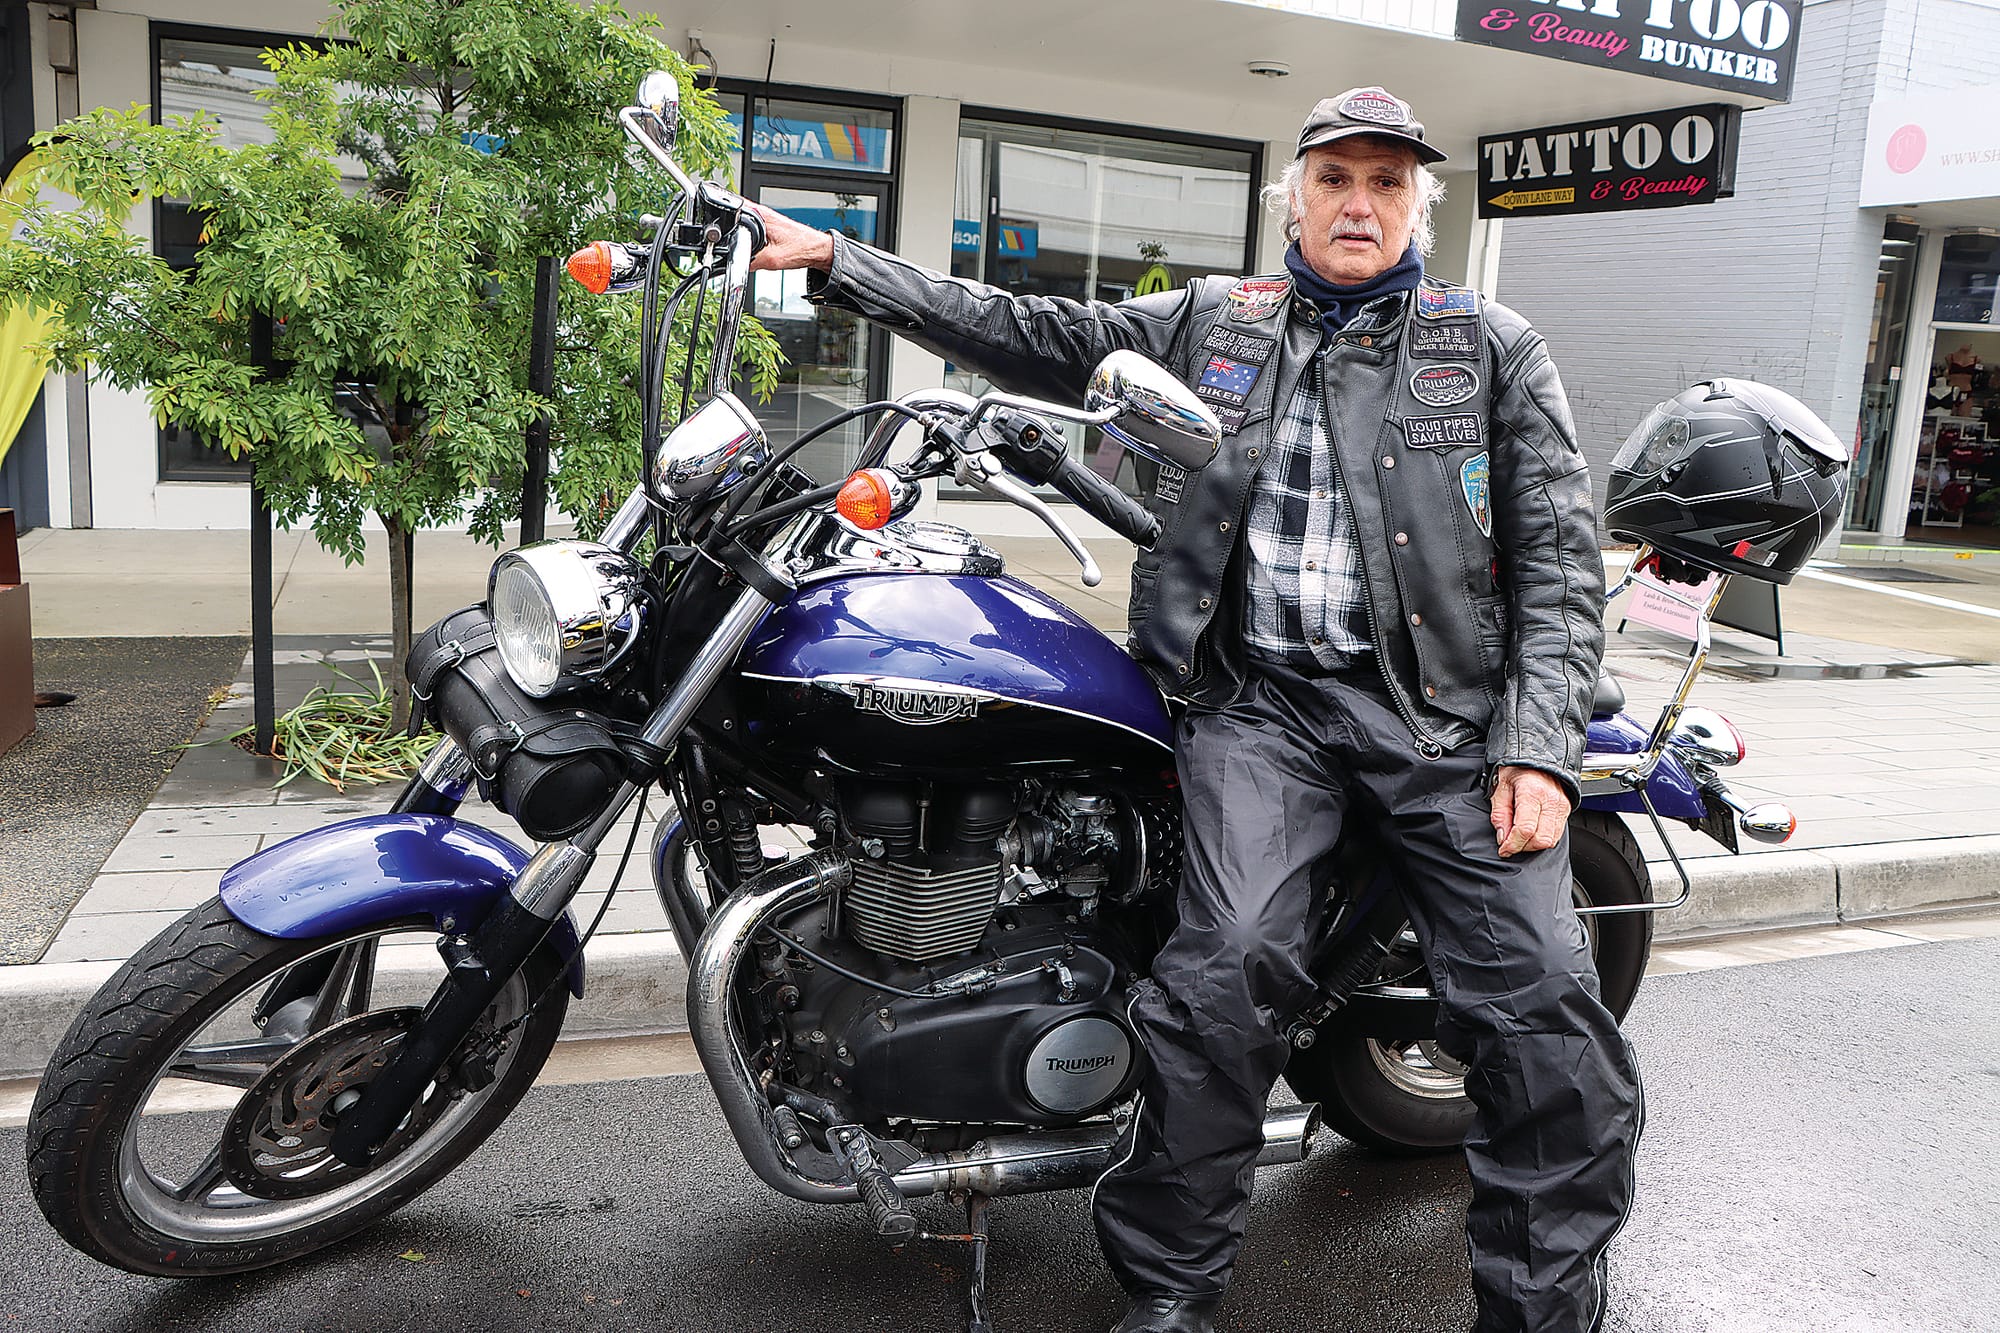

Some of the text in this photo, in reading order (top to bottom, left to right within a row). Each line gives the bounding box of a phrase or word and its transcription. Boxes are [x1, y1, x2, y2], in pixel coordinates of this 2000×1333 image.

[1479, 8, 1631, 58] & Beauty
[1639, 34, 1779, 85] BUNKER
[1347, 99, 1401, 115] TRIUMPH
[1484, 115, 1715, 183] TATTOO
[1589, 174, 1710, 202] & Beauty
[1503, 189, 1574, 206] DOWN LANE WAY
[1210, 326, 1275, 351] FEAR IS TEMPORARY
[1417, 336, 1451, 345] GRUMPY
[1420, 328, 1465, 339] G.O.B.B.
[1204, 335, 1269, 362] REGRET IS FOREVER
[1416, 374, 1470, 392] TRIUMPH
[1419, 385, 1473, 397] MOTORCYCLES
[1197, 386, 1243, 403] BIKER
[1218, 405, 1248, 419] THERAPY
[1409, 418, 1475, 432] LOUD PIPES
[1411, 429, 1478, 443] SAVE LIVES
[849, 680, 979, 726] TRIUMPH
[1045, 1055, 1116, 1075] TRIUMPH
